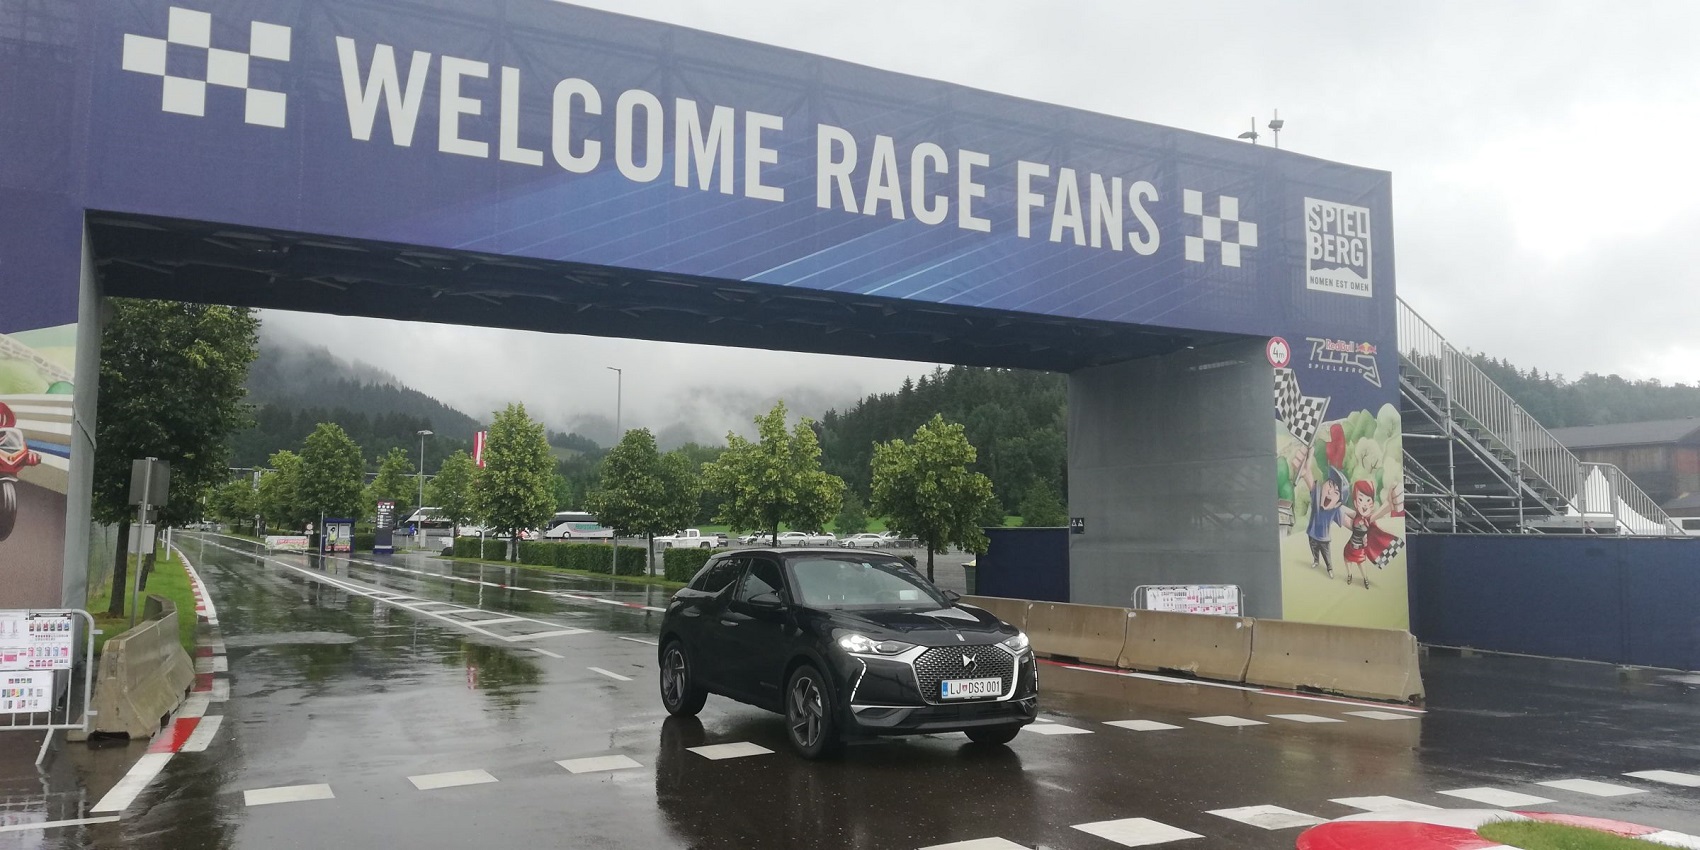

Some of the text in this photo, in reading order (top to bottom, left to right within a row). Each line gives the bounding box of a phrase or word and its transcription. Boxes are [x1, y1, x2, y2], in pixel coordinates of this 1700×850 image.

[336, 36, 1160, 255] WELCOME RACE FANS
[1309, 203, 1367, 238] SPIEL
[1310, 231, 1364, 267] BERG
[1310, 276, 1369, 292] NOMEN EST OMEN
[1308, 363, 1362, 373] SPIELBERG
[969, 682, 984, 693] DS3
[987, 681, 1000, 692] 001
